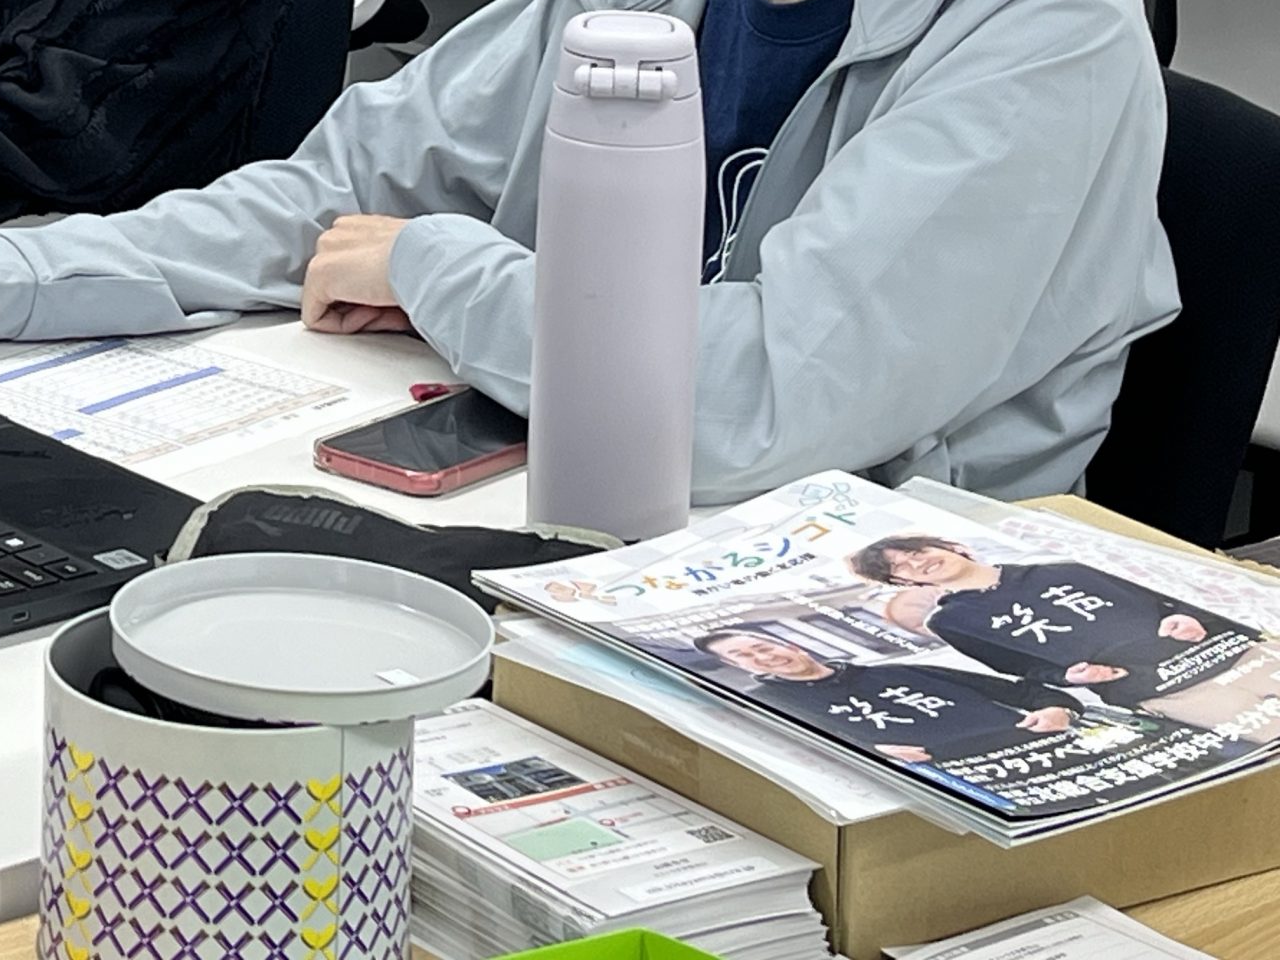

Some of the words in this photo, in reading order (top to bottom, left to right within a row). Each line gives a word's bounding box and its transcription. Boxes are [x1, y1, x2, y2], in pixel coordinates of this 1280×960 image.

[606, 511, 855, 597] つながるシゴト
[991, 585, 1114, 644] 笑声
[1156, 634, 1250, 681] Abilympics
[828, 686, 956, 729] 笑声
